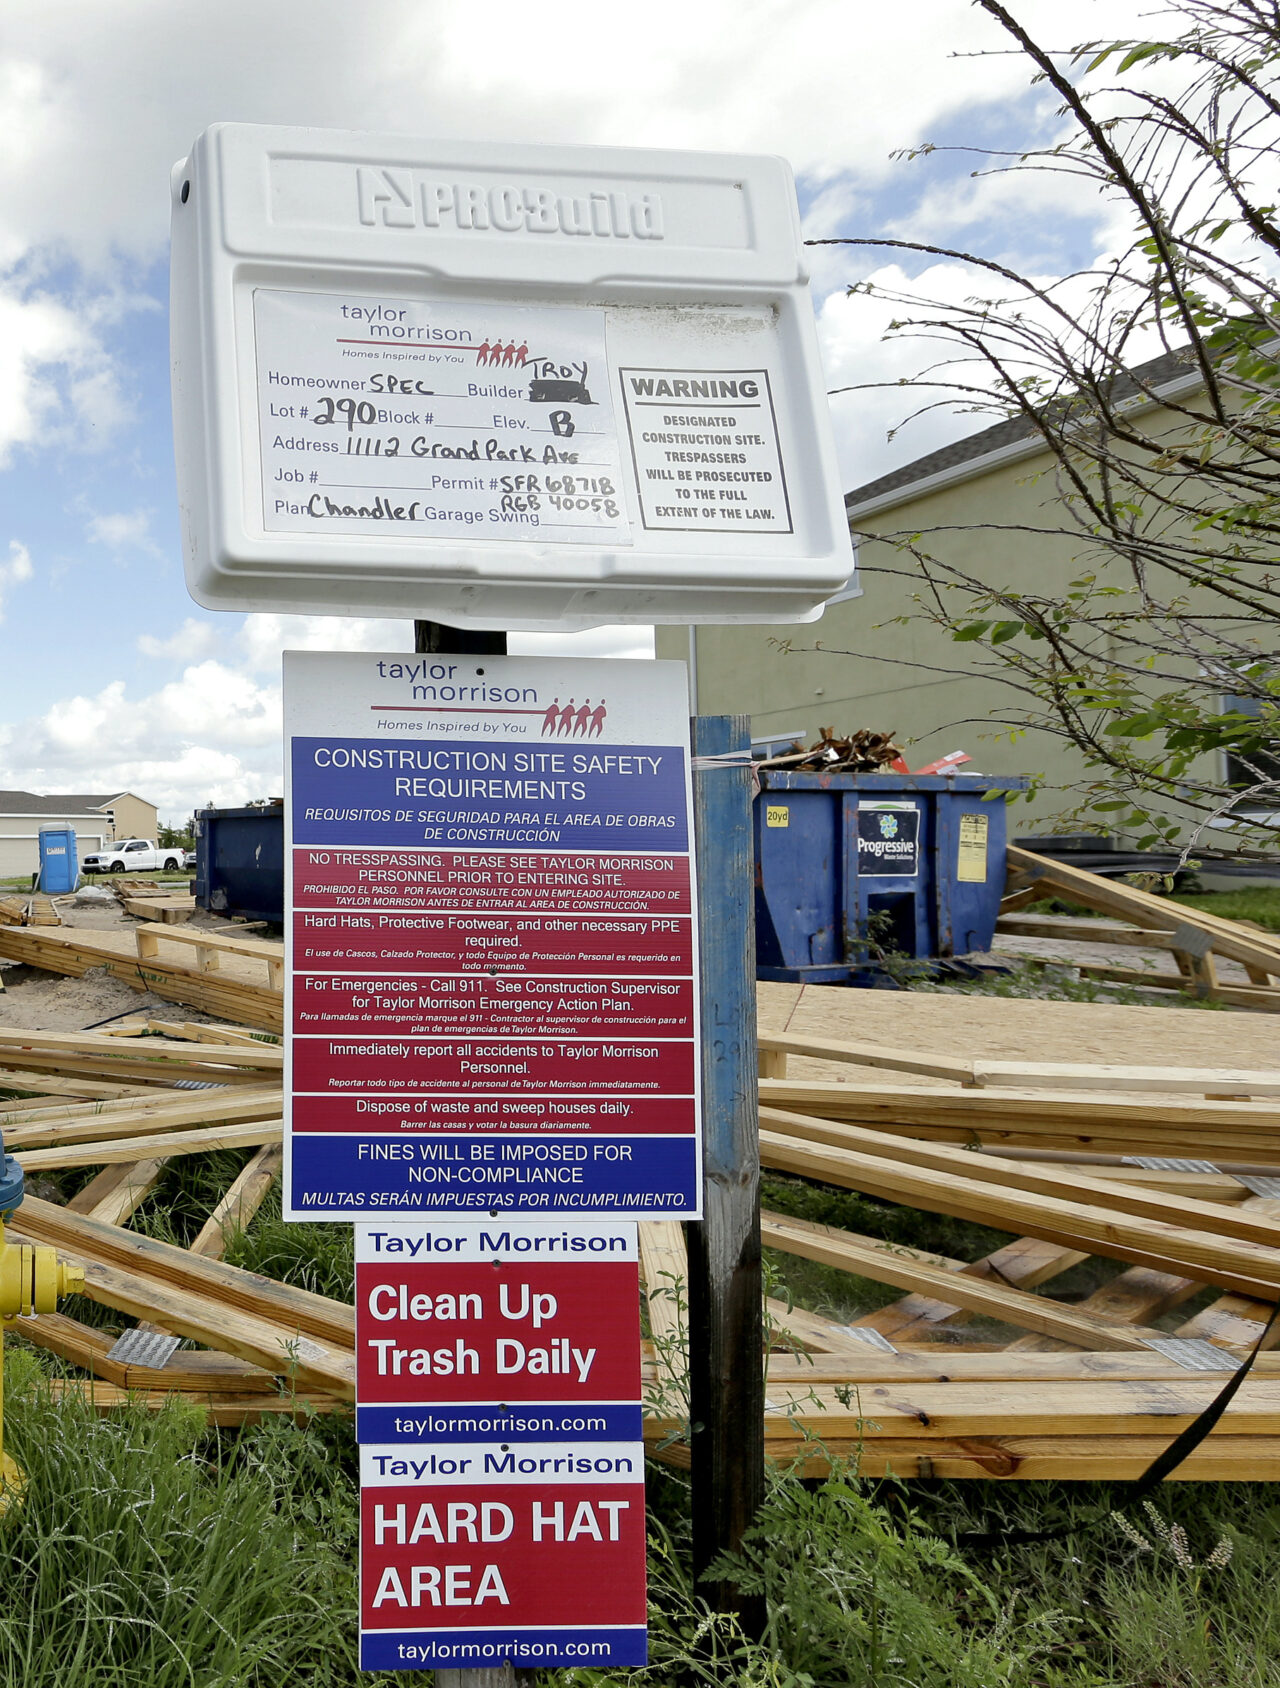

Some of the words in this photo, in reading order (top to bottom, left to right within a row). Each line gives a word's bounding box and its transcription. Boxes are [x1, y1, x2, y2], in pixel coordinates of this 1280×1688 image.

[340, 305, 407, 322] taylor
[370, 324, 472, 342] morrison
[342, 350, 380, 358] Homes
[382, 352, 426, 361] Inspired
[429, 354, 442, 363] by
[444, 355, 464, 363] You
[269, 371, 366, 390] Homeowner
[370, 374, 434, 395] SPEC
[468, 384, 523, 398] Builder
[522, 357, 588, 385] TROY
[630, 378, 758, 398] WARNING
[270, 404, 294, 418] Lot
[314, 397, 376, 432] 290
[378, 410, 420, 424] Block
[493, 415, 530, 429] Elev.
[549, 410, 575, 437] B
[663, 416, 736, 426] DESIGNATED
[642, 432, 731, 445] CONSTRUCTION
[735, 435, 765, 445] SITE.
[273, 436, 339, 452] Address
[347, 437, 400, 457] 11112
[411, 436, 480, 460] Grand
[486, 439, 536, 462] Park
[665, 452, 746, 463] TRESPASSERS
[274, 468, 304, 482] Job
[432, 476, 484, 490] Permit
[500, 475, 541, 493] SFR
[646, 469, 674, 480] WILL
[678, 470, 692, 480] BE
[696, 471, 772, 482] PROSECUTED
[676, 489, 690, 499] TO
[694, 490, 716, 500] THE
[719, 490, 747, 500] FULL
[275, 500, 310, 514] Plan
[309, 494, 420, 520] Chandler
[425, 507, 483, 524] Garage
[489, 509, 539, 526] Swing
[656, 506, 698, 517] EXTENT
[702, 508, 717, 518] OF
[720, 508, 742, 519] THE
[746, 509, 775, 519] LAW.
[376, 658, 457, 681] taylor
[411, 682, 537, 702] morrison
[377, 719, 423, 730] Homes
[426, 720, 479, 732] Inspired
[483, 722, 499, 734] by
[502, 722, 526, 732] You
[314, 748, 505, 771] CONSTRUCTION
[514, 753, 565, 772] SITE
[572, 754, 662, 775] SAFETY
[395, 777, 585, 800] REQUIREMENTS
[304, 808, 391, 821] REQUISITOS
[394, 810, 414, 821] DE
[417, 810, 500, 823] SEGURIDAD
[503, 812, 540, 824] PARA
[544, 813, 560, 825] EL
[562, 813, 601, 825] AREA
[605, 814, 624, 826] DE
[627, 814, 675, 827] OBRAS
[768, 811, 787, 823] 20yd
[857, 838, 914, 856] Progressive
[309, 852, 330, 864] NO
[333, 853, 445, 866] TRESSPASSING.
[453, 855, 506, 867] PLEASE
[510, 856, 537, 868] SEE
[540, 857, 595, 869] TAYLOR
[599, 858, 673, 870] MORRISON
[359, 869, 444, 882] PERSONNEL
[448, 871, 491, 883] PRIOR
[495, 872, 514, 883] TO
[518, 872, 588, 885] ENTERING
[592, 873, 625, 885] SITE.
[303, 884, 355, 894] PROHIBIDO
[357, 885, 368, 894] EL
[371, 885, 398, 894] PASO.
[403, 886, 423, 895] POR
[425, 886, 456, 895] FAVOR
[458, 887, 509, 896] CONSULTE
[511, 888, 532, 896] CON
[534, 888, 549, 897] UN
[551, 888, 603, 898] EMPLEADO
[603, 890, 665, 899] AUTORIZADO
[667, 890, 680, 899] DE
[304, 914, 336, 927] Hard
[340, 915, 374, 929] Hats,
[379, 915, 444, 928] Protective
[448, 916, 512, 931] Footwear,
[516, 918, 540, 930] and
[544, 918, 578, 930] other
[581, 921, 647, 934] necessary
[651, 919, 680, 932] PPE
[465, 934, 521, 949] required.
[305, 977, 328, 990] For
[331, 978, 417, 993] Emergencies
[430, 979, 455, 991] Call
[459, 979, 487, 992] 911.
[495, 979, 521, 992] See
[525, 980, 607, 993] Construction
[611, 981, 680, 996] Supervisor
[356, 1099, 410, 1115] Dispose
[414, 1100, 427, 1112] of
[430, 1101, 469, 1113] waste
[473, 1101, 498, 1113] and
[502, 1103, 545, 1116] sweep
[549, 1101, 596, 1113] houses
[599, 1101, 633, 1116] daily.
[400, 1120, 427, 1128] Barrer
[428, 1120, 441, 1128] las
[468, 1122, 474, 1130] y
[499, 1120, 507, 1128] la
[509, 1120, 537, 1128] basura
[539, 1121, 591, 1129] diariamente.
[358, 1144, 414, 1160] FINES
[419, 1144, 464, 1160] WILL
[470, 1144, 494, 1160] BE
[501, 1144, 587, 1160] IMPOSED
[593, 1145, 632, 1160] FOR
[409, 1166, 583, 1183] NON-COMPLIANCE
[302, 1192, 365, 1205] MULTAS
[369, 1191, 422, 1205] SERÁN
[426, 1192, 514, 1206] IMPUESTAS
[518, 1193, 549, 1206] POR
[553, 1192, 686, 1206] INCUMPLIMIENTO.
[367, 1232, 467, 1253] Taylor
[479, 1231, 626, 1251] Morrison
[368, 1284, 482, 1320] Clean
[499, 1283, 557, 1328] Up
[368, 1338, 479, 1375] Trash
[496, 1338, 596, 1382] Daily
[394, 1414, 606, 1436] taylormorrison.com
[372, 1454, 471, 1477] Taylor
[484, 1453, 632, 1473] Morrison
[374, 1501, 513, 1544] HARD
[532, 1500, 629, 1541] HAT
[371, 1564, 509, 1607] AREA
[397, 1639, 610, 1662] taylormorrison.com
